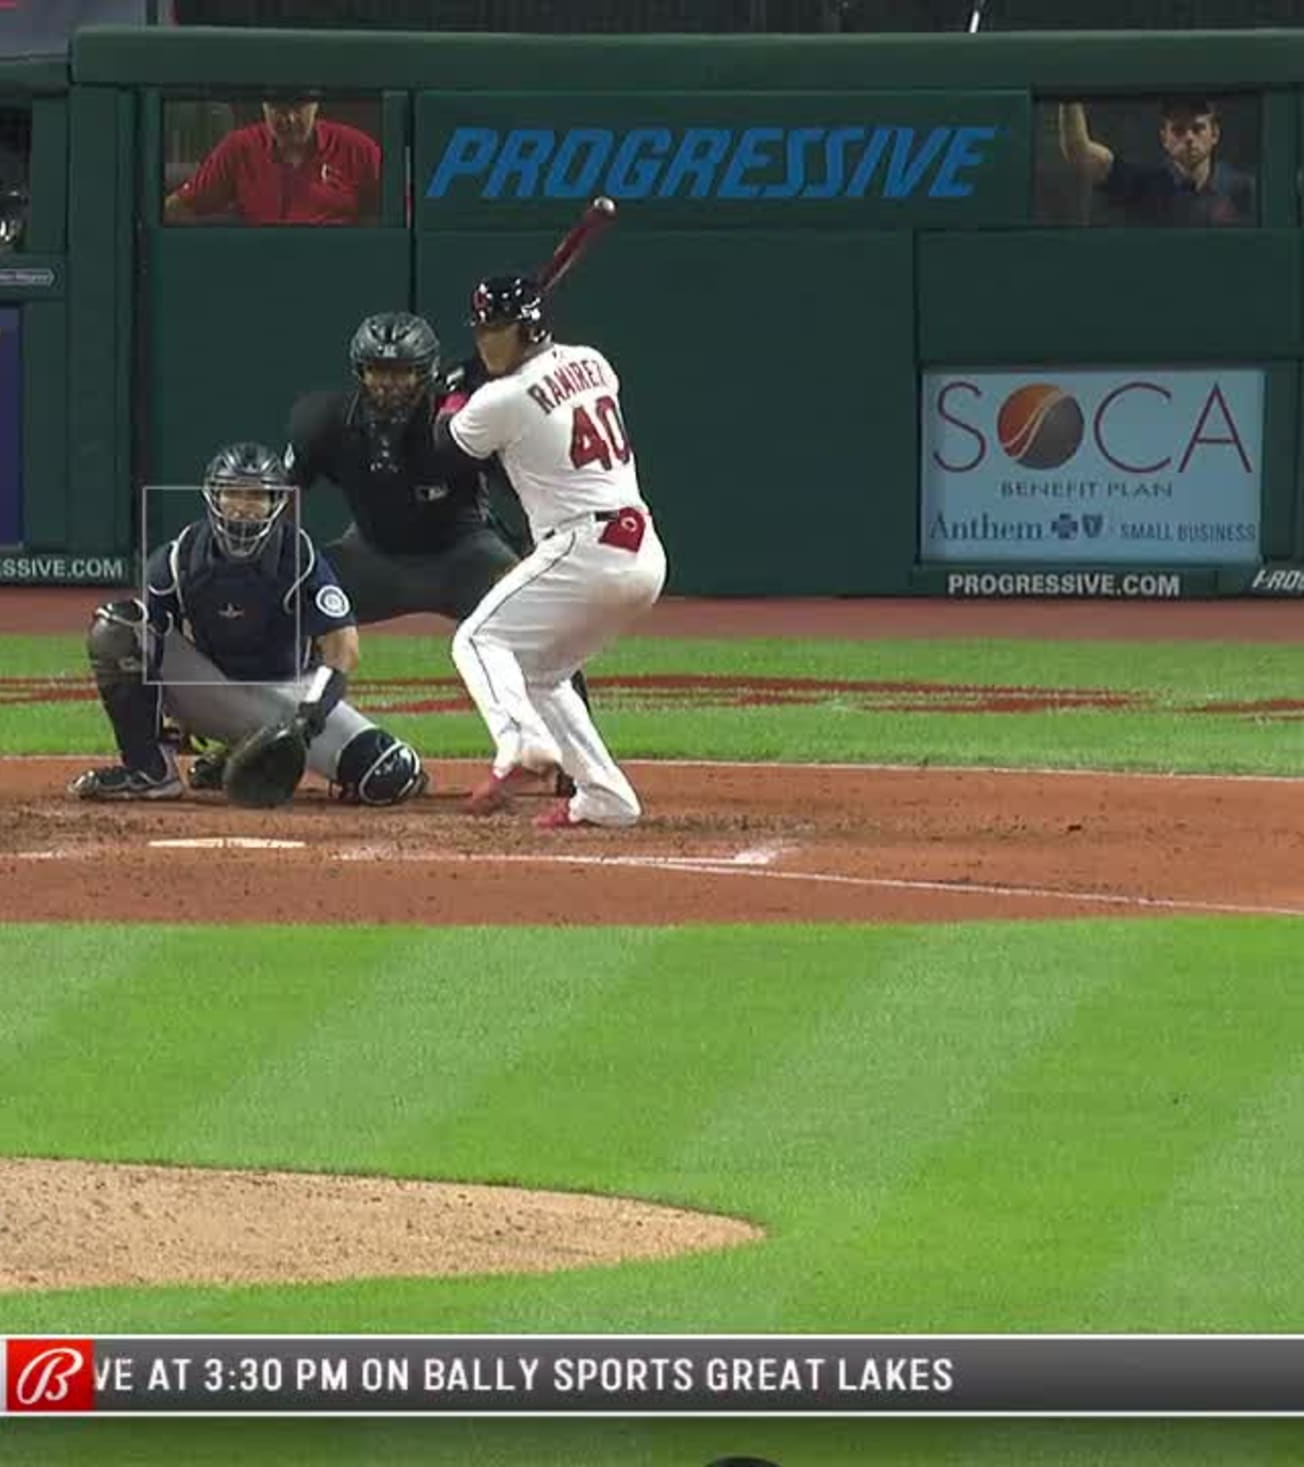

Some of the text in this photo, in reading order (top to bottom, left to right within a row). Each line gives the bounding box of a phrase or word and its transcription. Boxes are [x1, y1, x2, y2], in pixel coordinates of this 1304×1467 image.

[426, 126, 997, 199] PROGRESSIVE
[569, 395, 632, 471] 40
[932, 381, 1253, 474] SOCA
[1000, 481, 1173, 498] BENEFIT PLAN
[930, 513, 1042, 542] Anthem
[1120, 522, 1256, 543] SMALL BUSINESS
[947, 573, 1180, 596] PROGRESSIVE.COM
